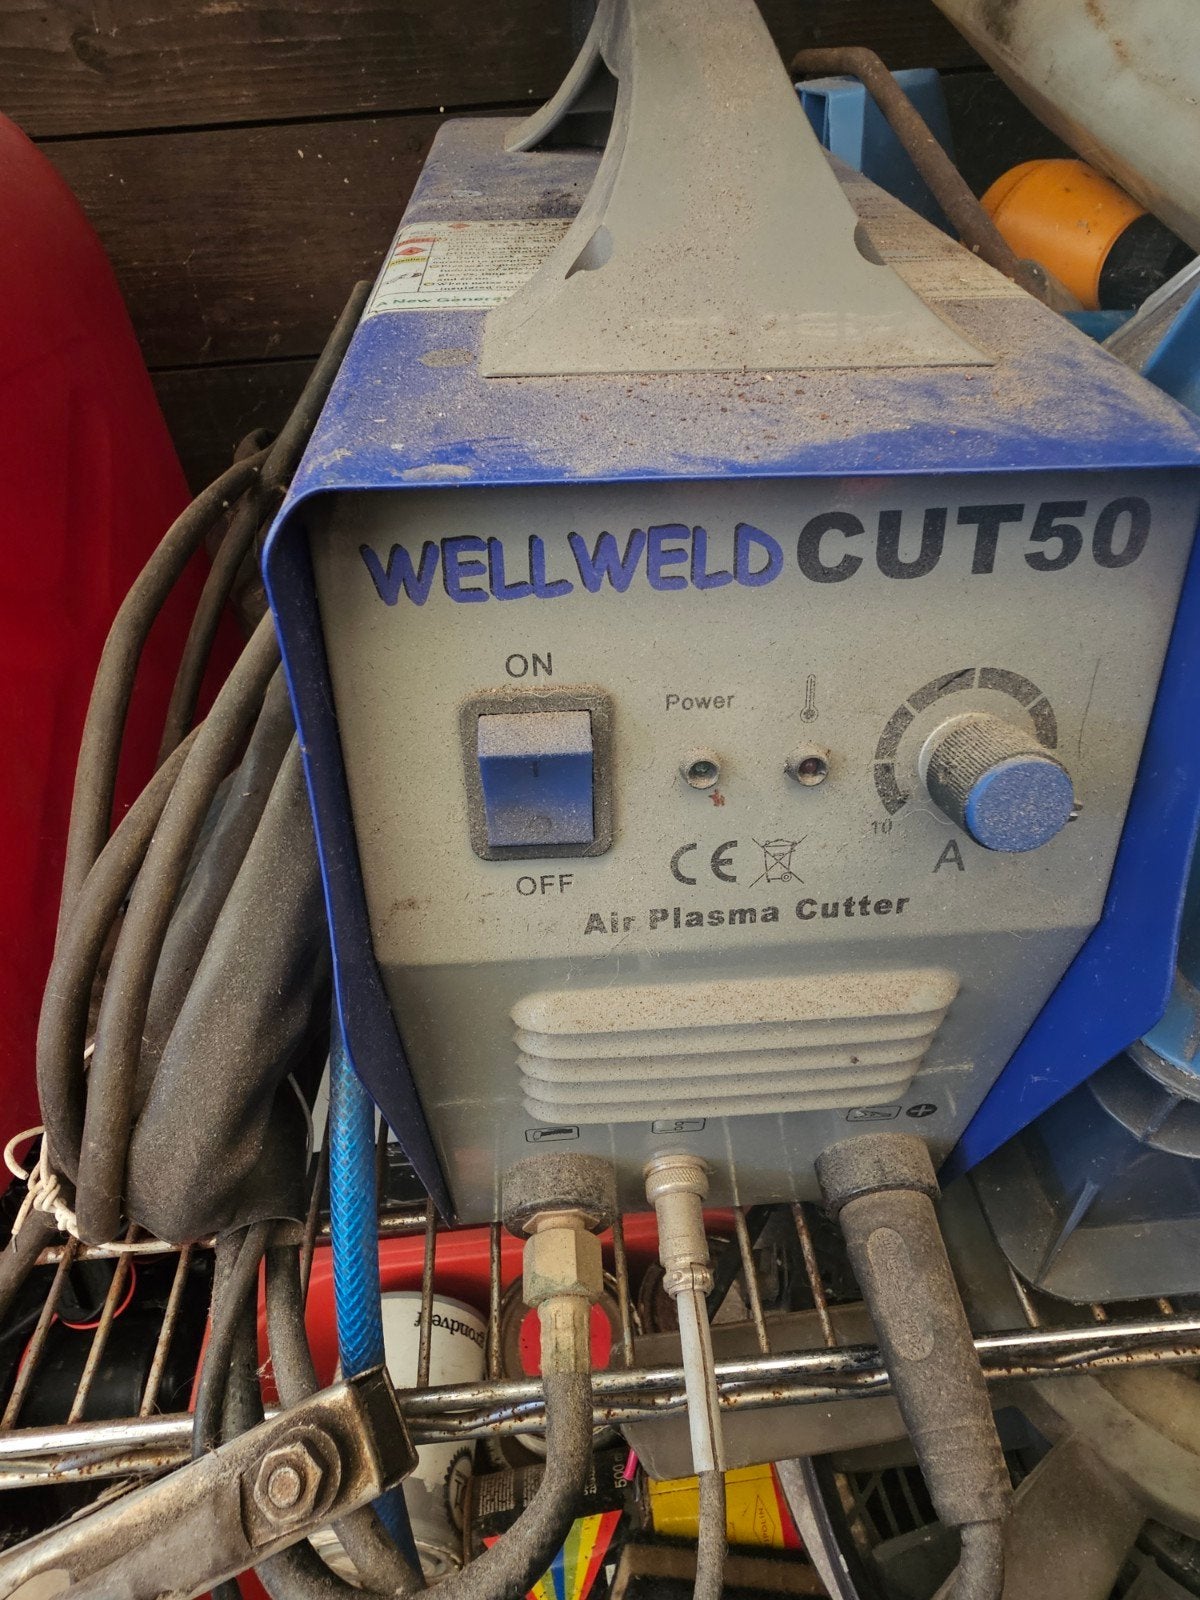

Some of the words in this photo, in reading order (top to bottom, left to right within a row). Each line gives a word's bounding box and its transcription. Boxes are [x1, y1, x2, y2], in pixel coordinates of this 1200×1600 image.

[359, 522, 784, 606] WELLWELD
[796, 496, 1152, 584] CUT50
[504, 652, 554, 678] ON
[664, 692, 735, 712] Power
[871, 818, 893, 834] 10
[670, 840, 738, 886] CE
[931, 839, 965, 873] A
[516, 873, 574, 897] OFF
[584, 911, 636, 935] Air
[649, 905, 780, 931] Plasma
[794, 894, 911, 921] Cutter
[414, 1311, 486, 1349] grondvef
[612, 1463, 628, 1489] 500
